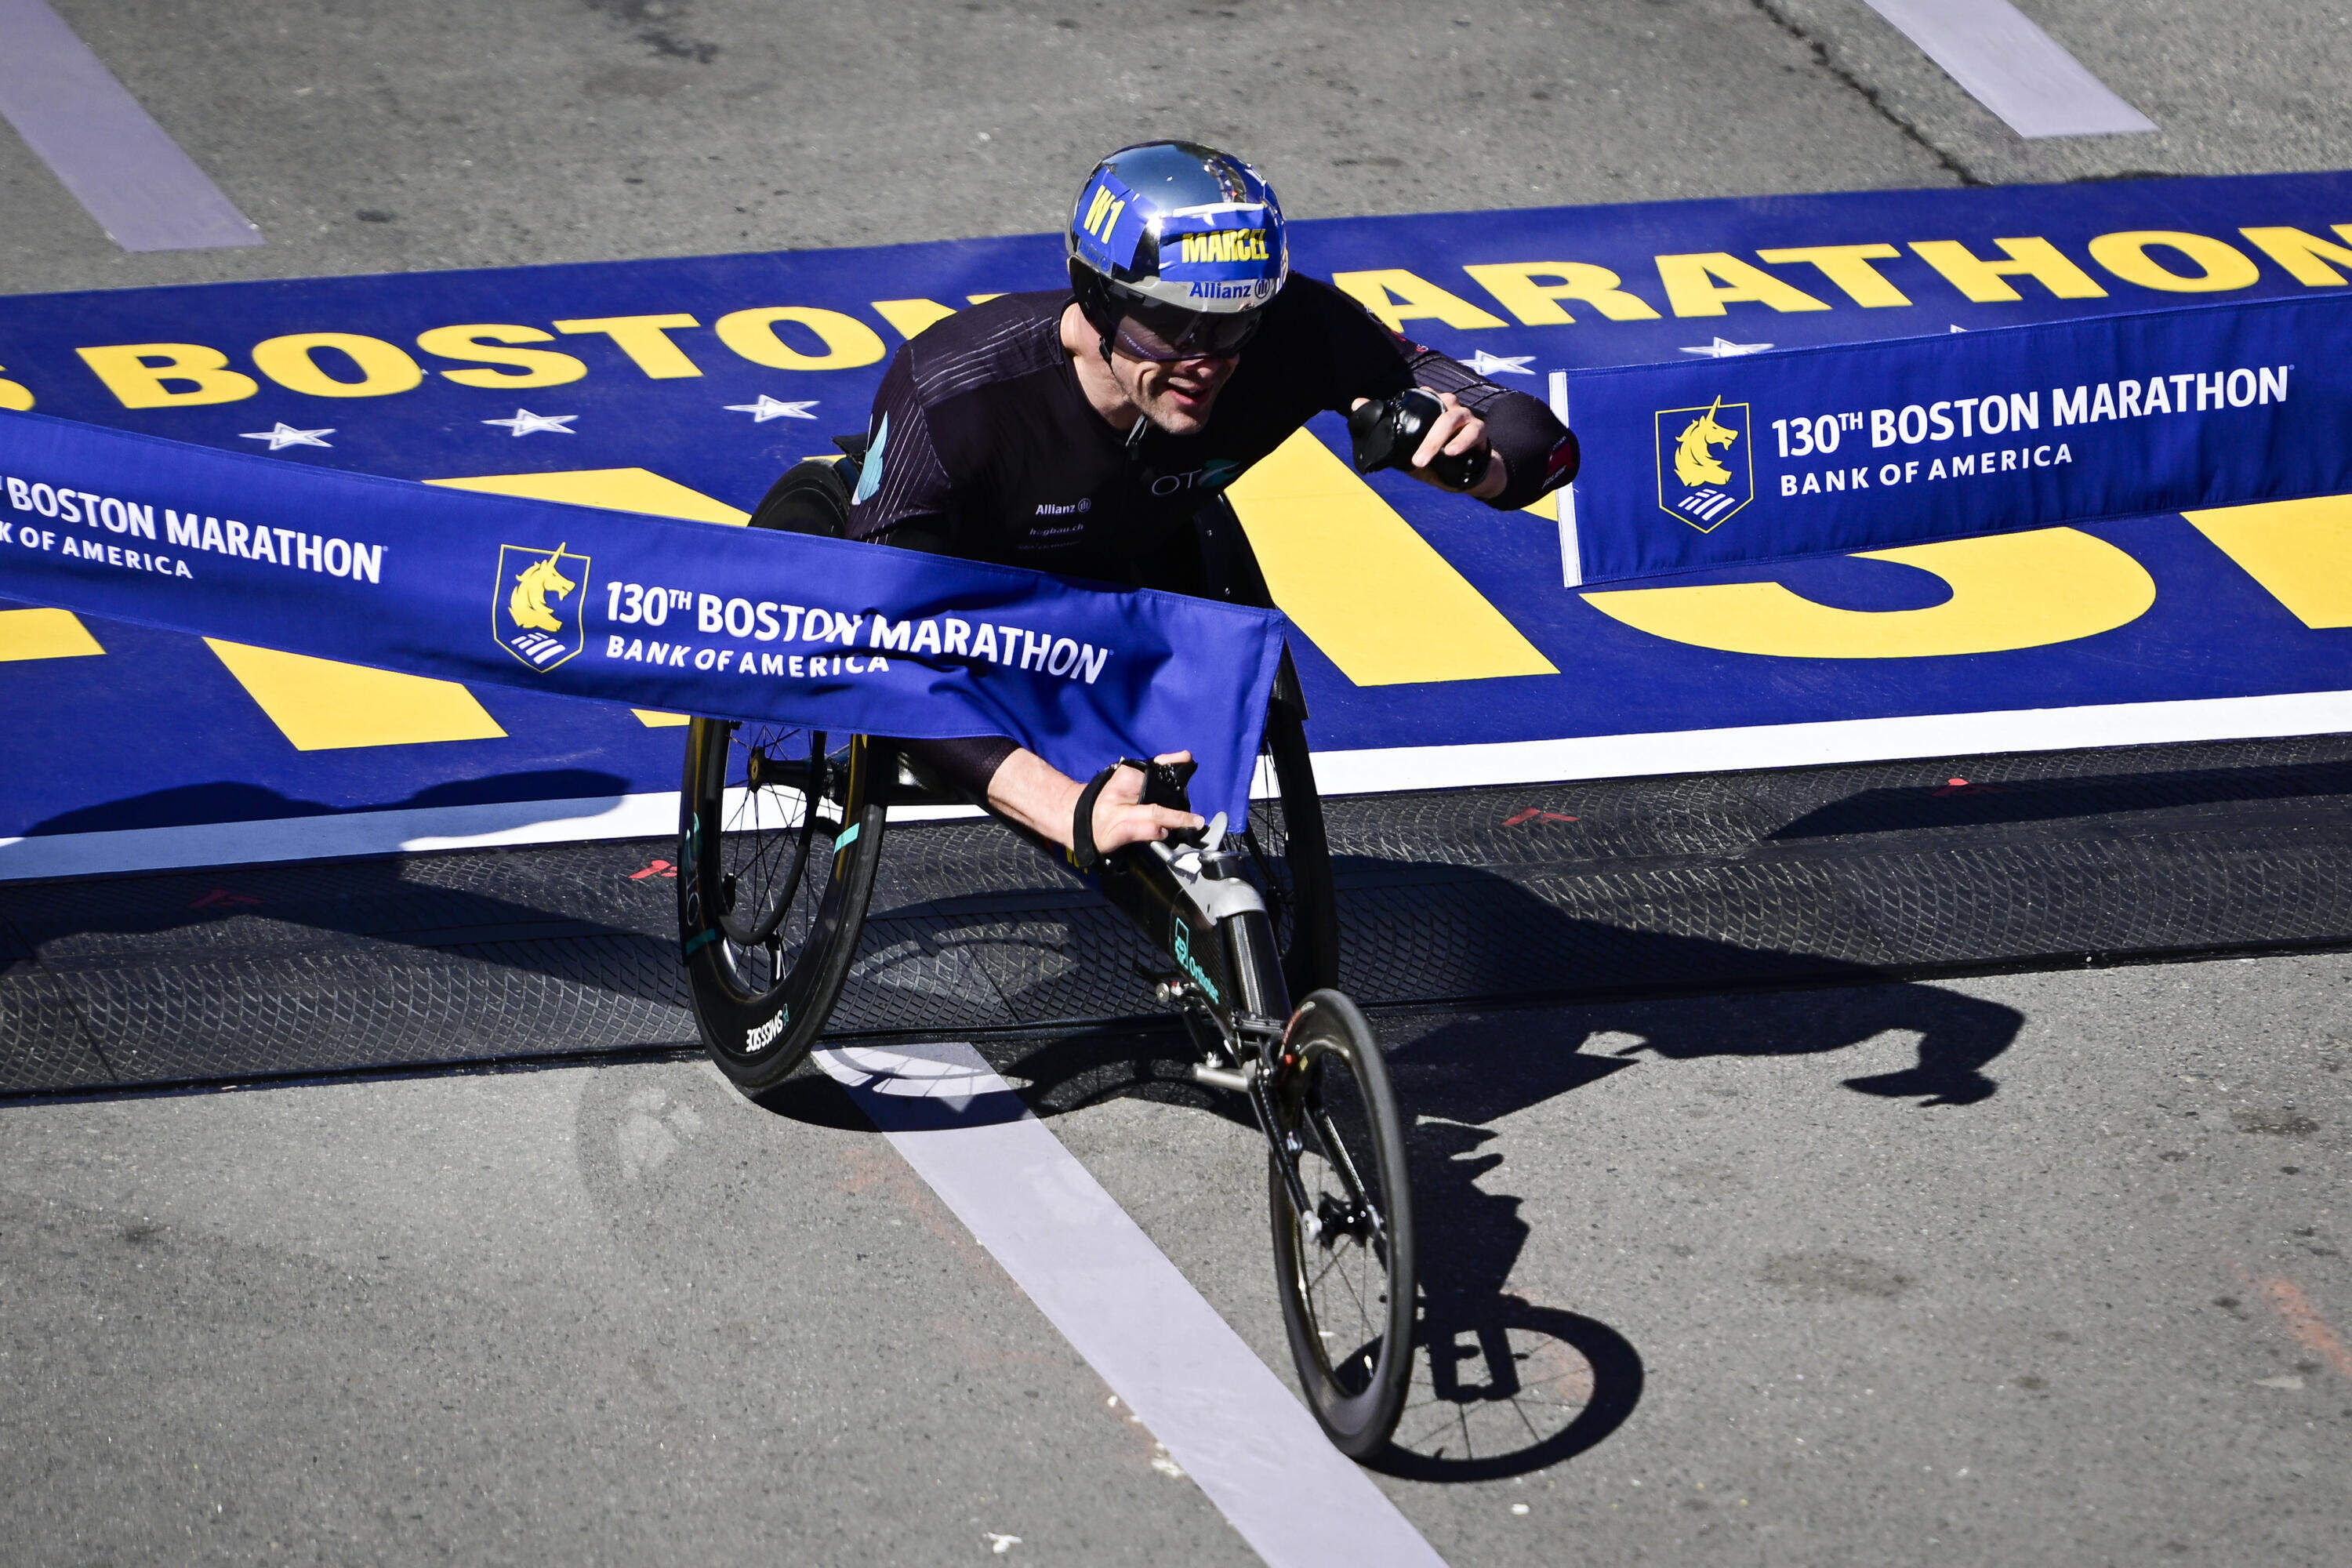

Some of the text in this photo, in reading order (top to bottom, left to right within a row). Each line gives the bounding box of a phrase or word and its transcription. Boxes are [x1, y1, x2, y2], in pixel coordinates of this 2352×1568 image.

[1083, 184, 1126, 245] W1
[1181, 228, 1269, 263] MARCEL
[1189, 281, 1252, 299] Allianz
[1772, 365, 2288, 458] 130TH BOSTON MARATHON
[1780, 445, 2072, 497] BANK OF AMERICA
[7, 476, 383, 584] BOSTON MARATHON
[1035, 503, 1076, 516] Allianz
[20, 526, 56, 551] OF
[63, 536, 194, 579] AMERICA
[605, 634, 890, 678] BANK OF AMERICA
[606, 581, 1109, 684] 130TH BOSTON MARATHON
